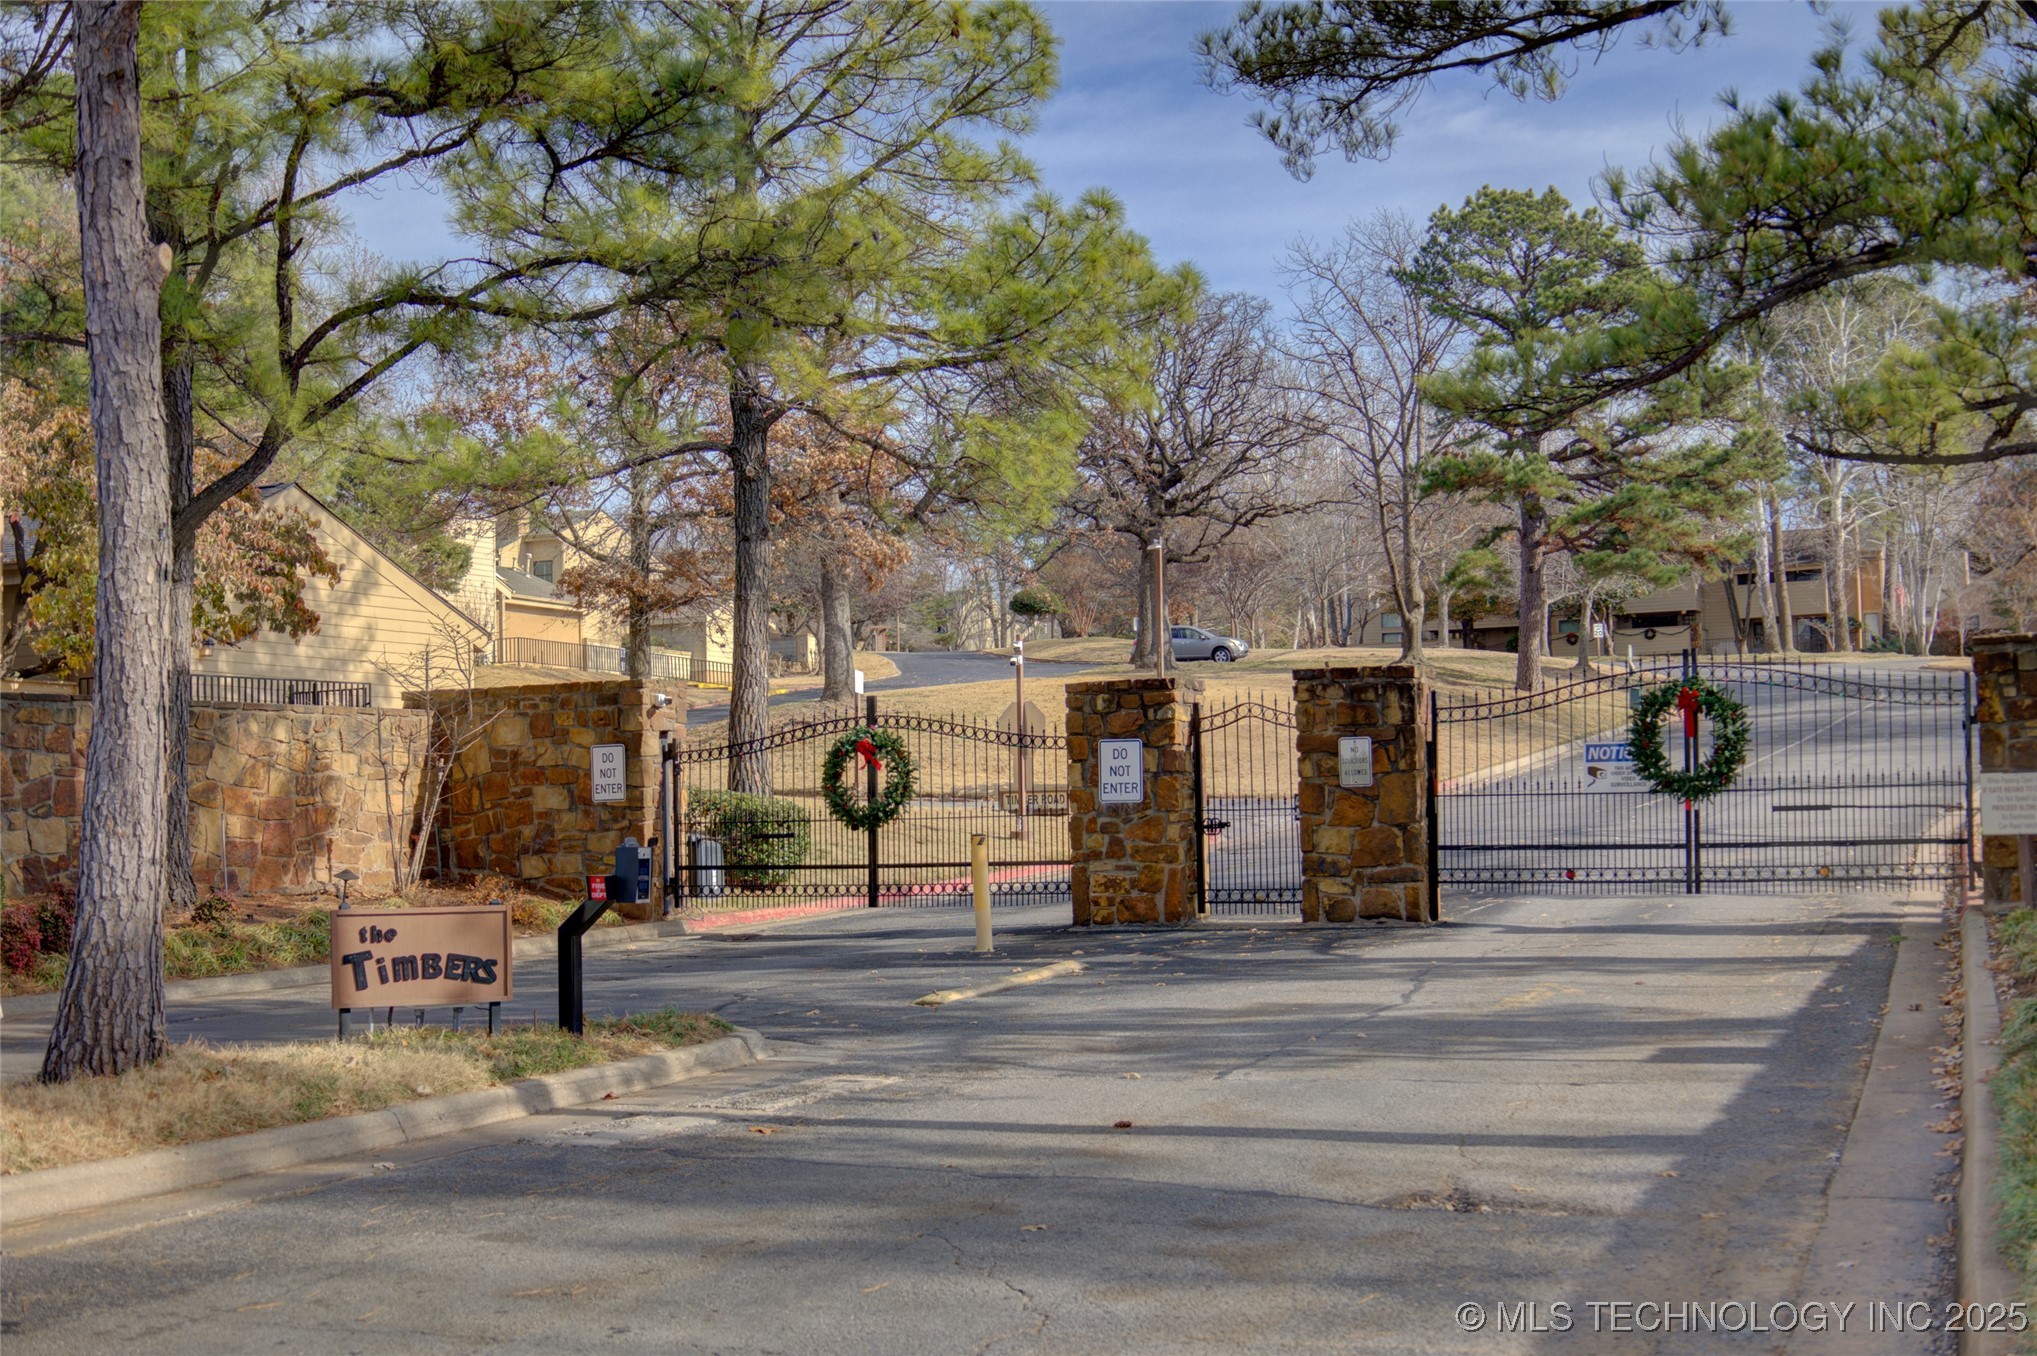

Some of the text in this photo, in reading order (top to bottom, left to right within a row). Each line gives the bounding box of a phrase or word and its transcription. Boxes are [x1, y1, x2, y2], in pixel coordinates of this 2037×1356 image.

[601, 752, 614, 763] DO
[1112, 748, 1128, 760] DO
[1588, 746, 1635, 760] NOTIC
[600, 767, 617, 779] NOT
[1109, 765, 1131, 777] NOT
[595, 783, 623, 795] ENTER
[1103, 782, 1139, 794] ENTER
[1042, 794, 1066, 805] ROAD
[359, 925, 398, 944] the
